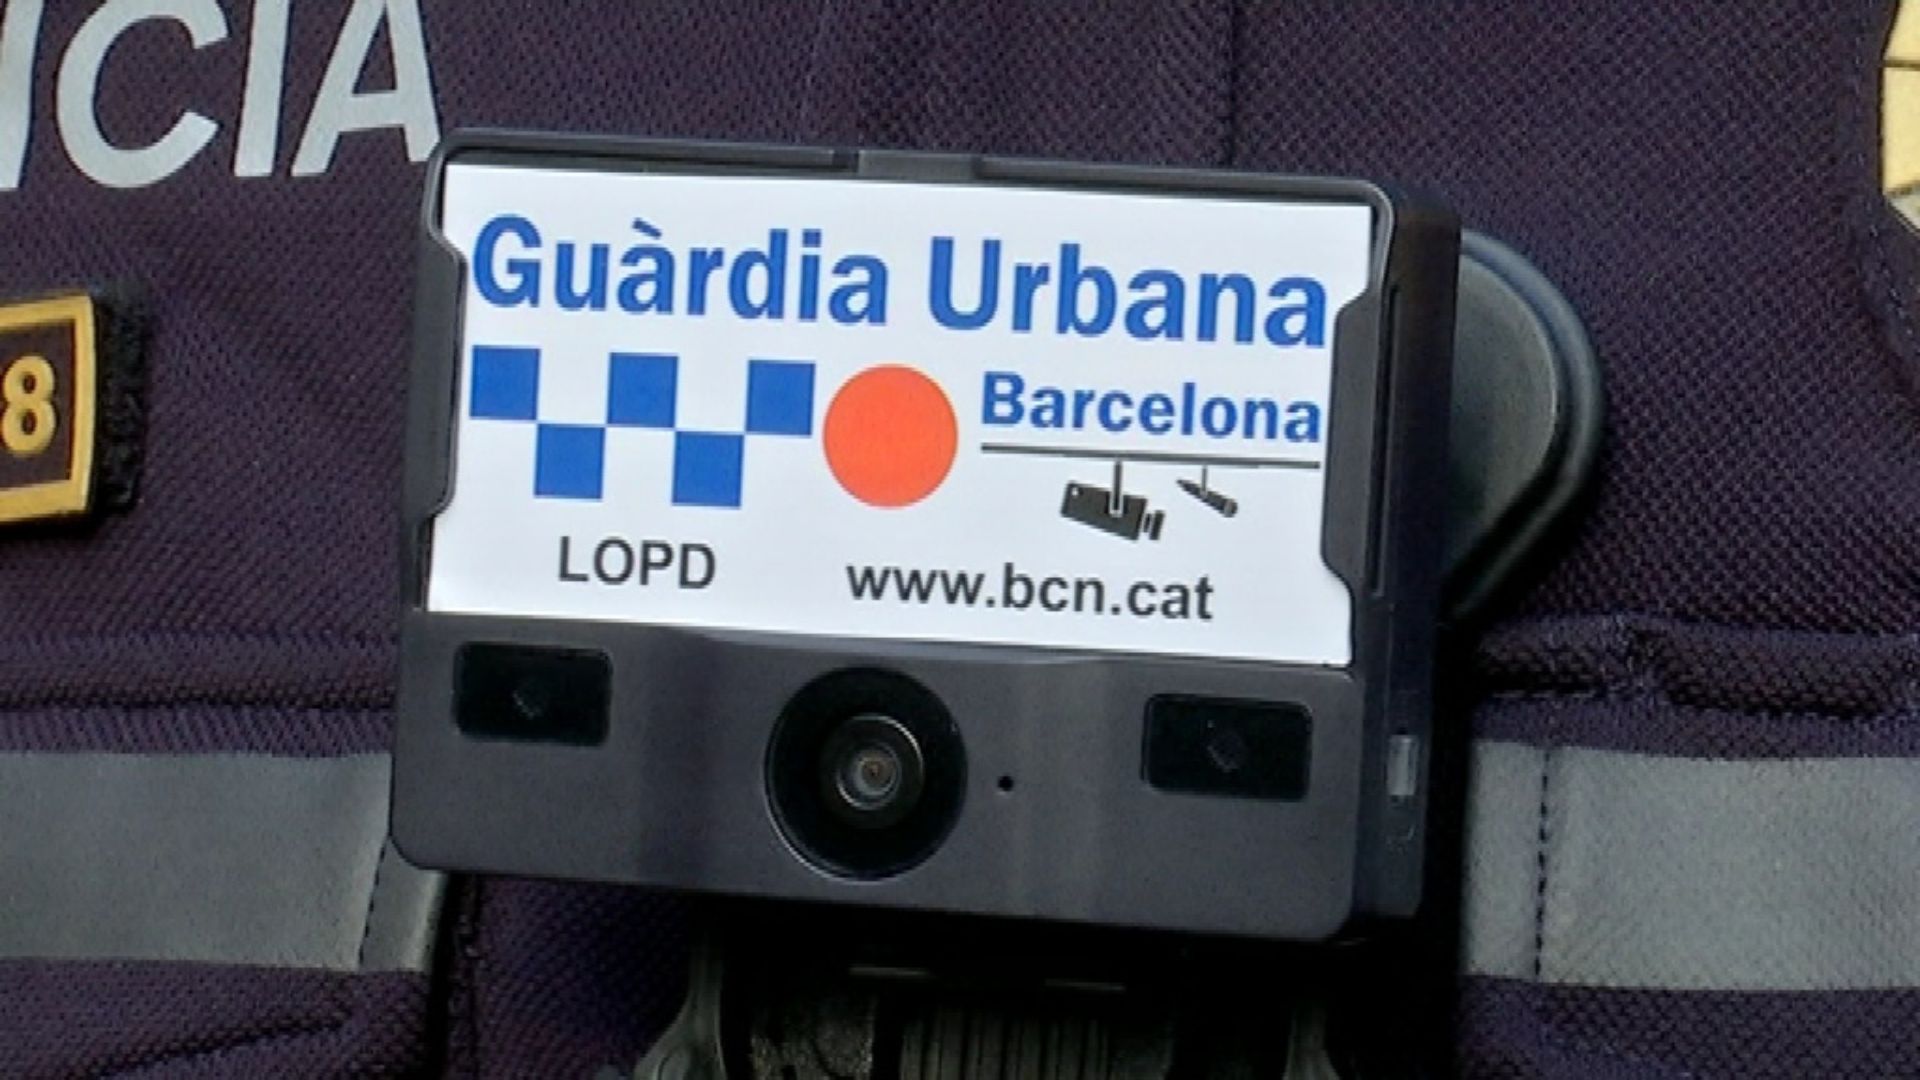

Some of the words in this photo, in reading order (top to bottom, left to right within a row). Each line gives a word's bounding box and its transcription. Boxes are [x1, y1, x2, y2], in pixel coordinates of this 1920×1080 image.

[472, 214, 889, 326] Guàrdia
[928, 236, 1328, 349] Urbana
[1, 355, 56, 455] 8
[982, 371, 1321, 444] Barcelona
[559, 535, 716, 590] LOPD
[846, 561, 1214, 621] www.bcn.cat
